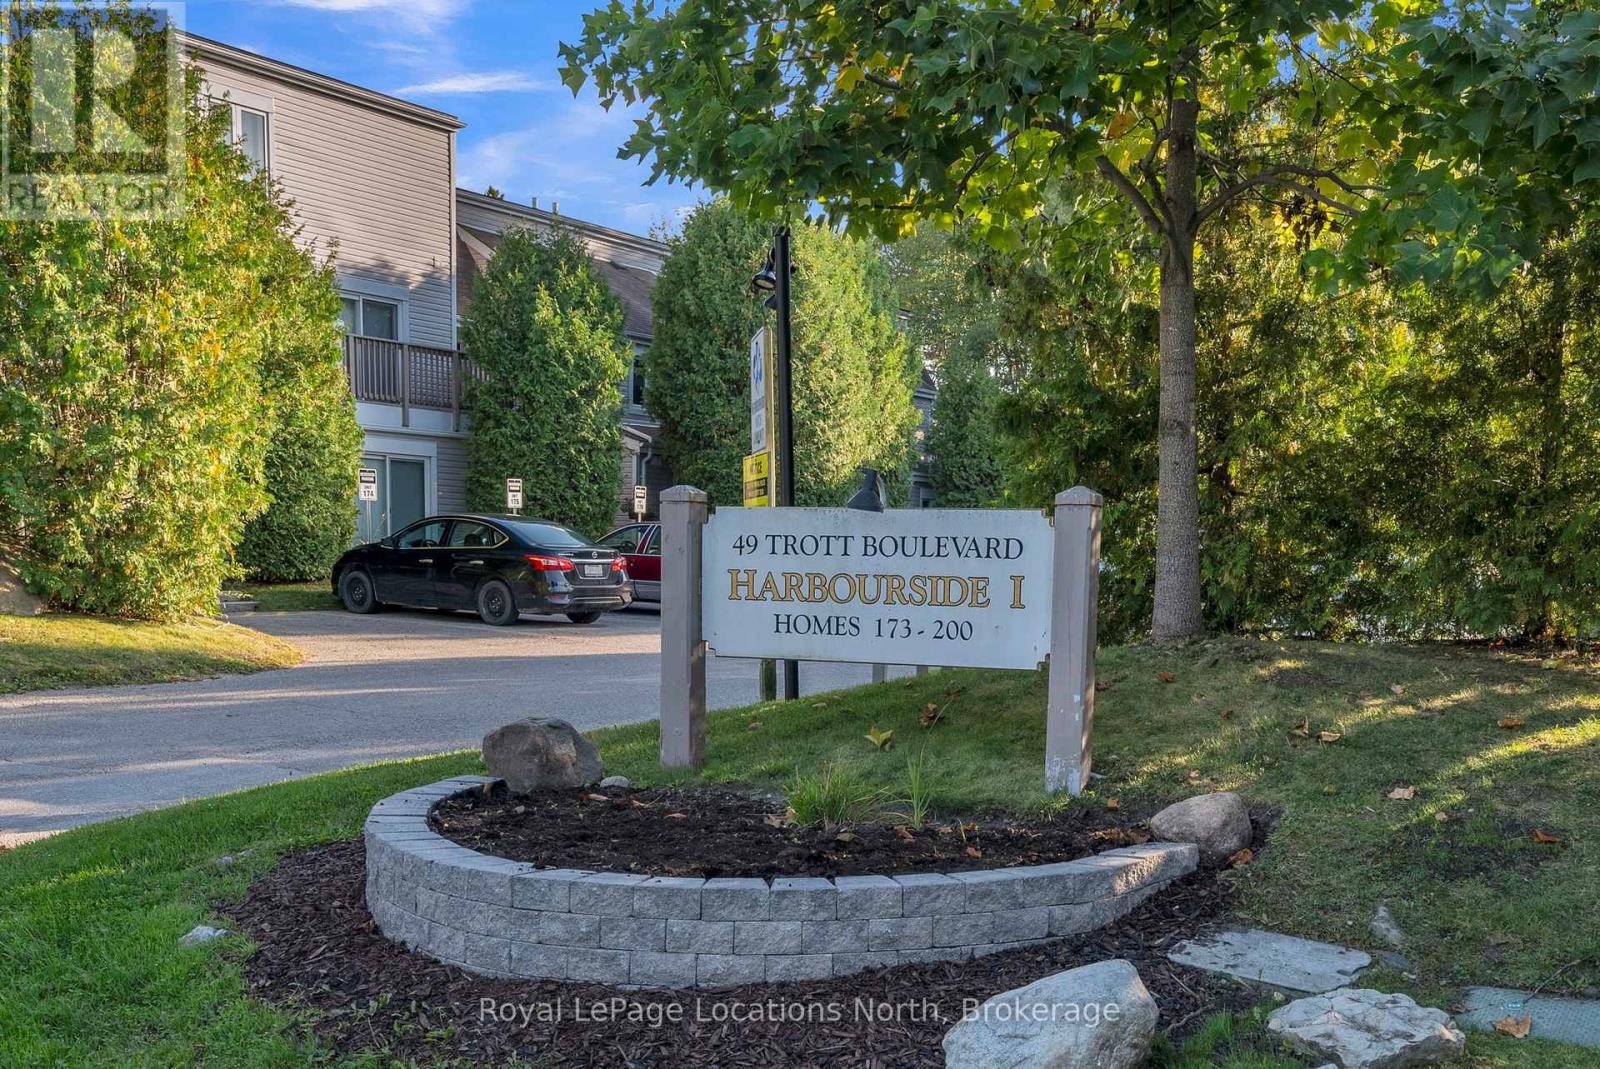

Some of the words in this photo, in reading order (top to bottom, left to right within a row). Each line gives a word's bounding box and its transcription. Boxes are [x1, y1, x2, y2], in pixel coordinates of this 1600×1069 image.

[732, 534, 758, 556] 49
[765, 534, 855, 557] TROTT
[862, 535, 1024, 560] BOULEVARD
[728, 569, 991, 608] HARBOURSIDE
[1009, 575, 1025, 609] I
[774, 614, 861, 637] HOMES
[874, 618, 912, 639] 173
[932, 620, 974, 641] 200
